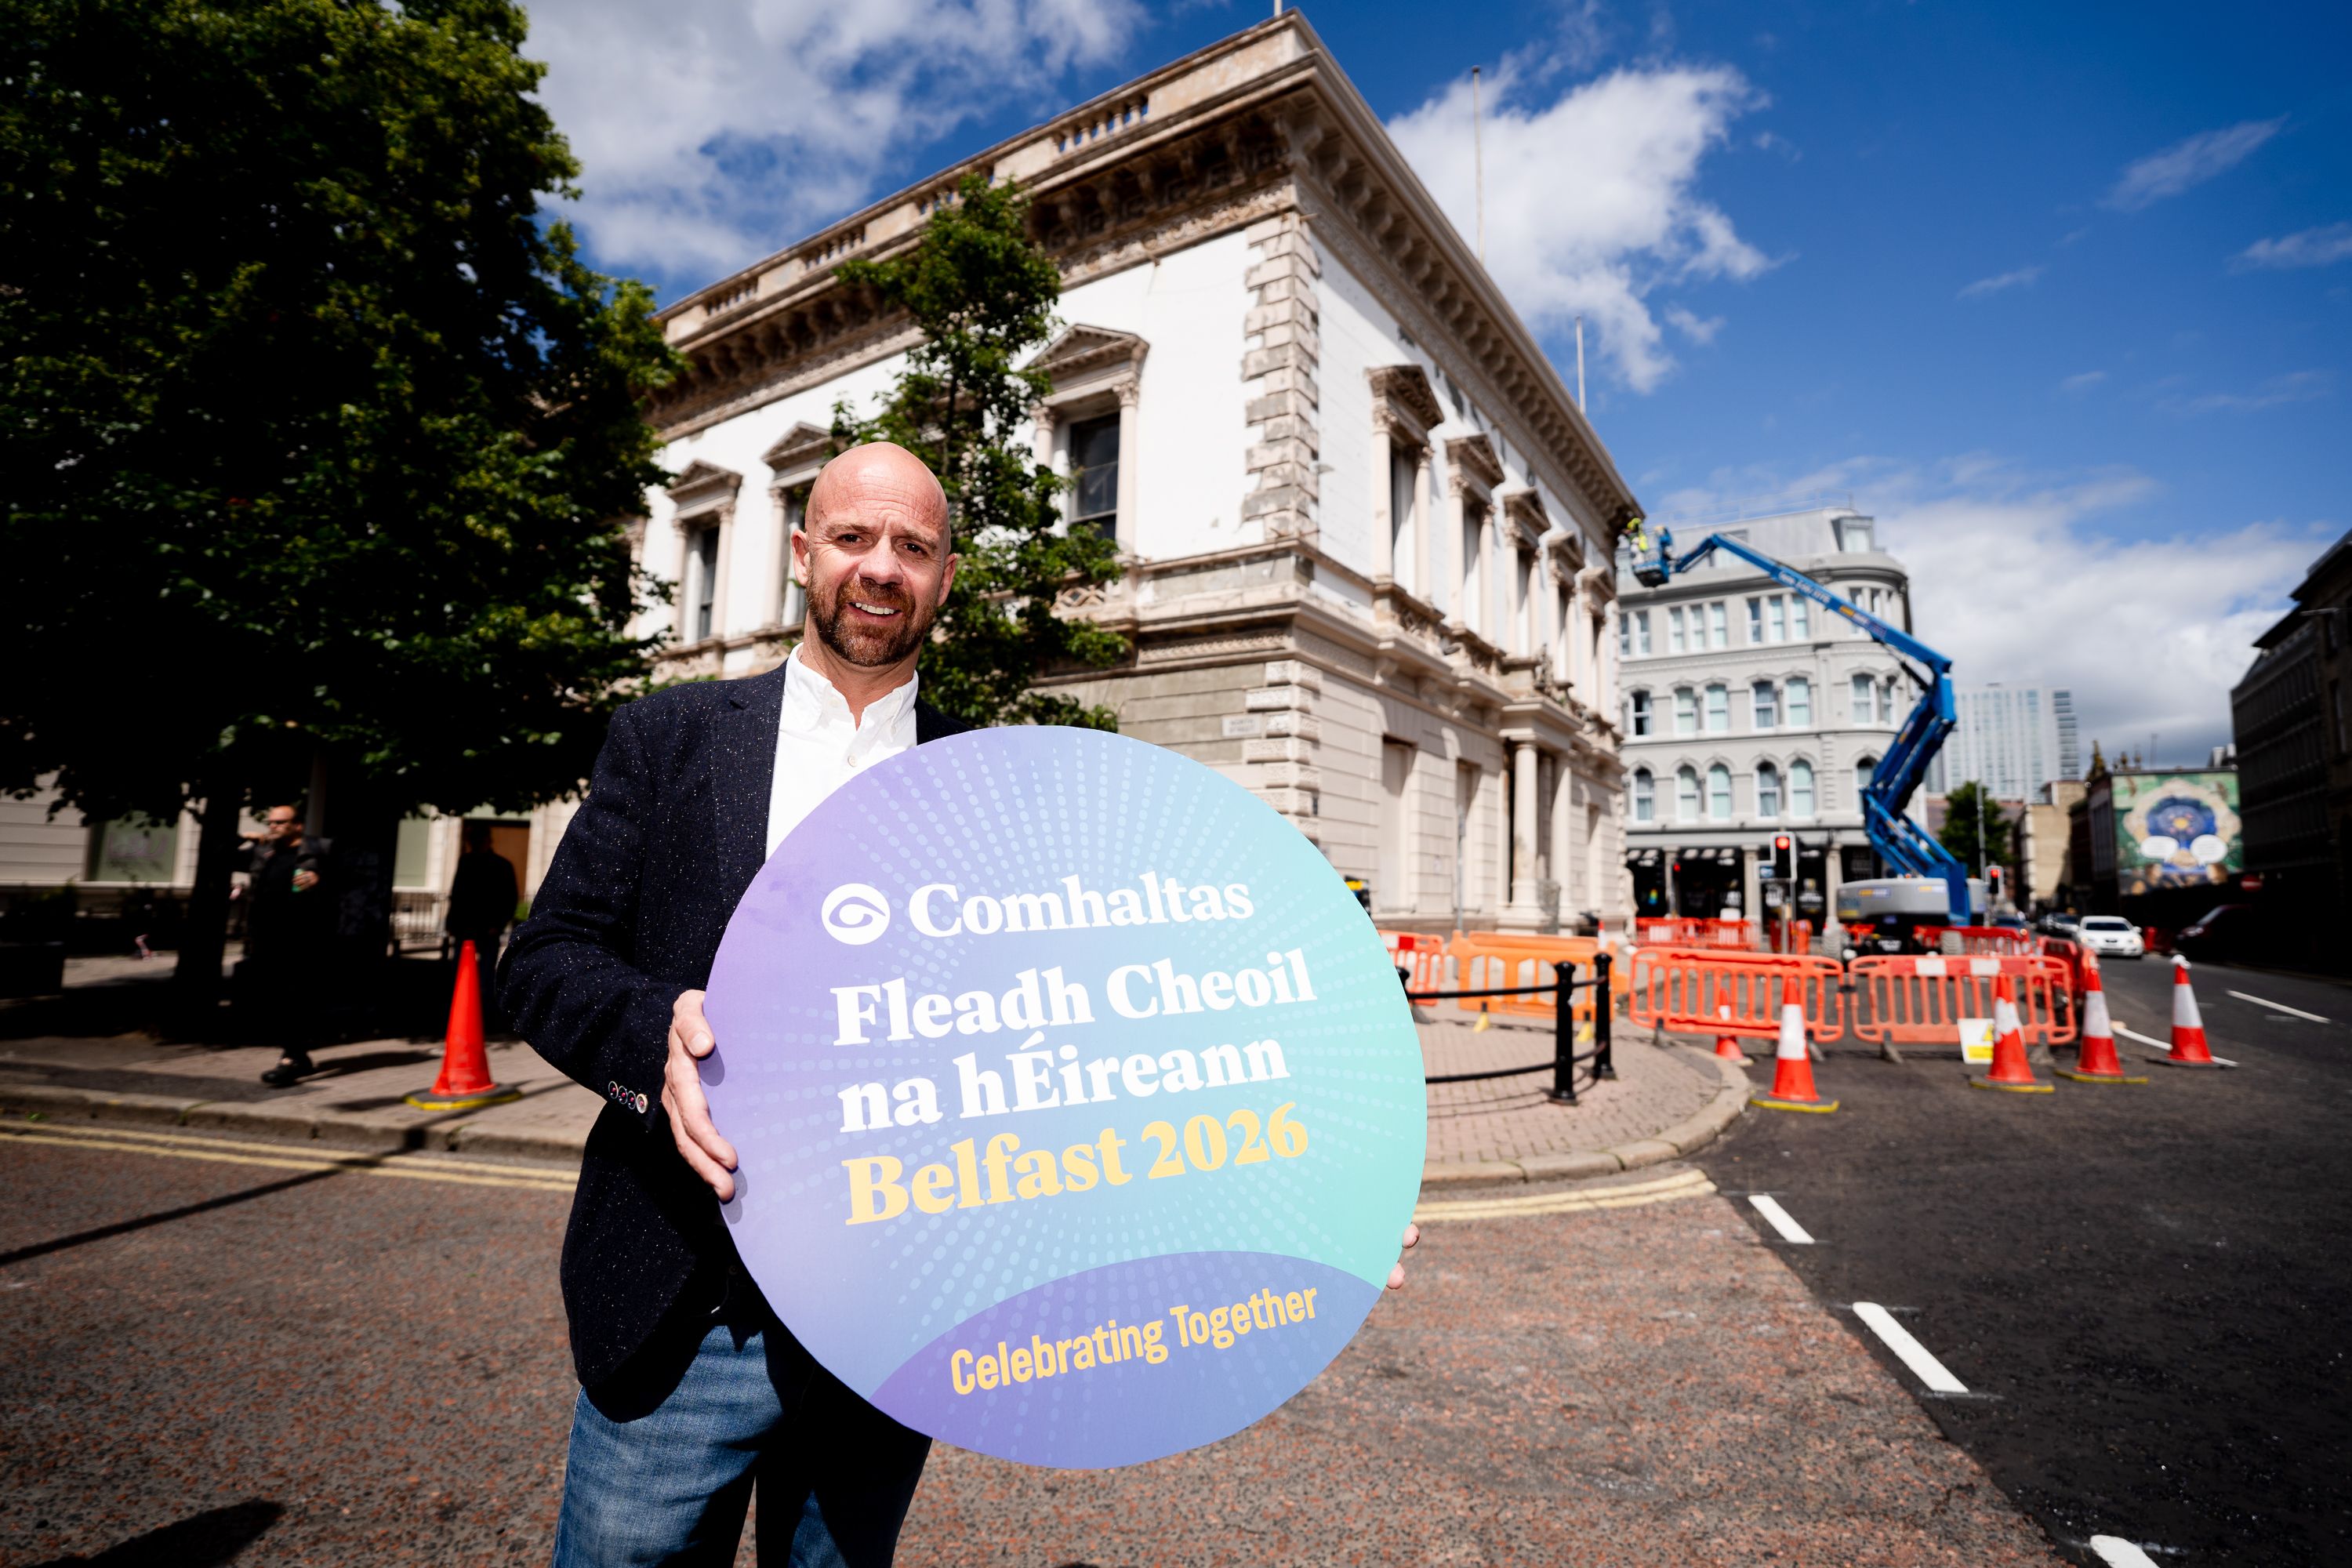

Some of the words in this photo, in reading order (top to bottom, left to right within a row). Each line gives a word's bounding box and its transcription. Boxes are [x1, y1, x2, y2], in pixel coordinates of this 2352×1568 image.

[909, 871, 1254, 938] Comhaltas
[830, 965, 1095, 1046] Fleadh
[1106, 949, 1317, 1018] Cheoil
[837, 1078, 943, 1133] na
[953, 1031, 1290, 1118] hÉireann
[842, 1132, 1131, 1225] Belfast
[1141, 1102, 1308, 1179] 2026
[950, 1320, 1168, 1396] Celebrating
[1169, 1286, 1318, 1348] Together
